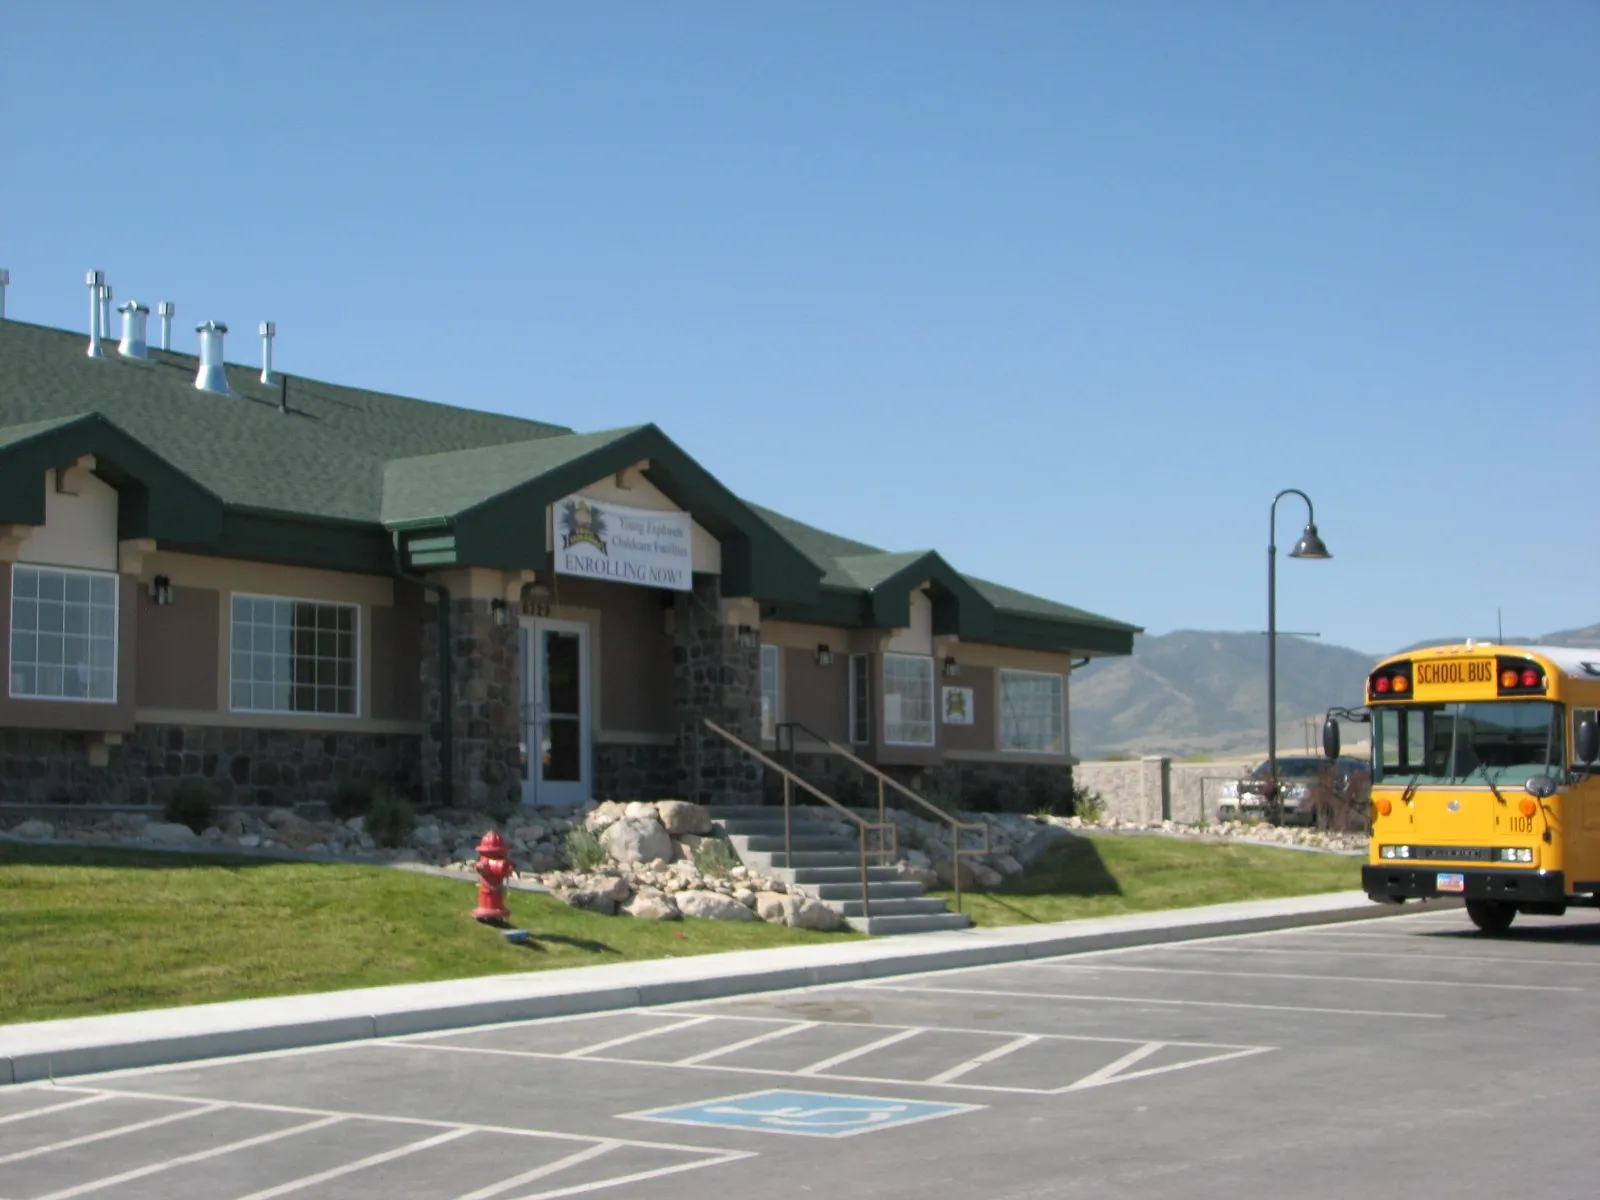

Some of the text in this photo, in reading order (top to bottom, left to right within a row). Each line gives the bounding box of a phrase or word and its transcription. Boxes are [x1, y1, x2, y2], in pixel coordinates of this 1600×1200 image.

[565, 554, 682, 584] ENROLLING NOW!
[1417, 661, 1493, 684] SCHOOL BUS
[1510, 816, 1533, 833] 1108
